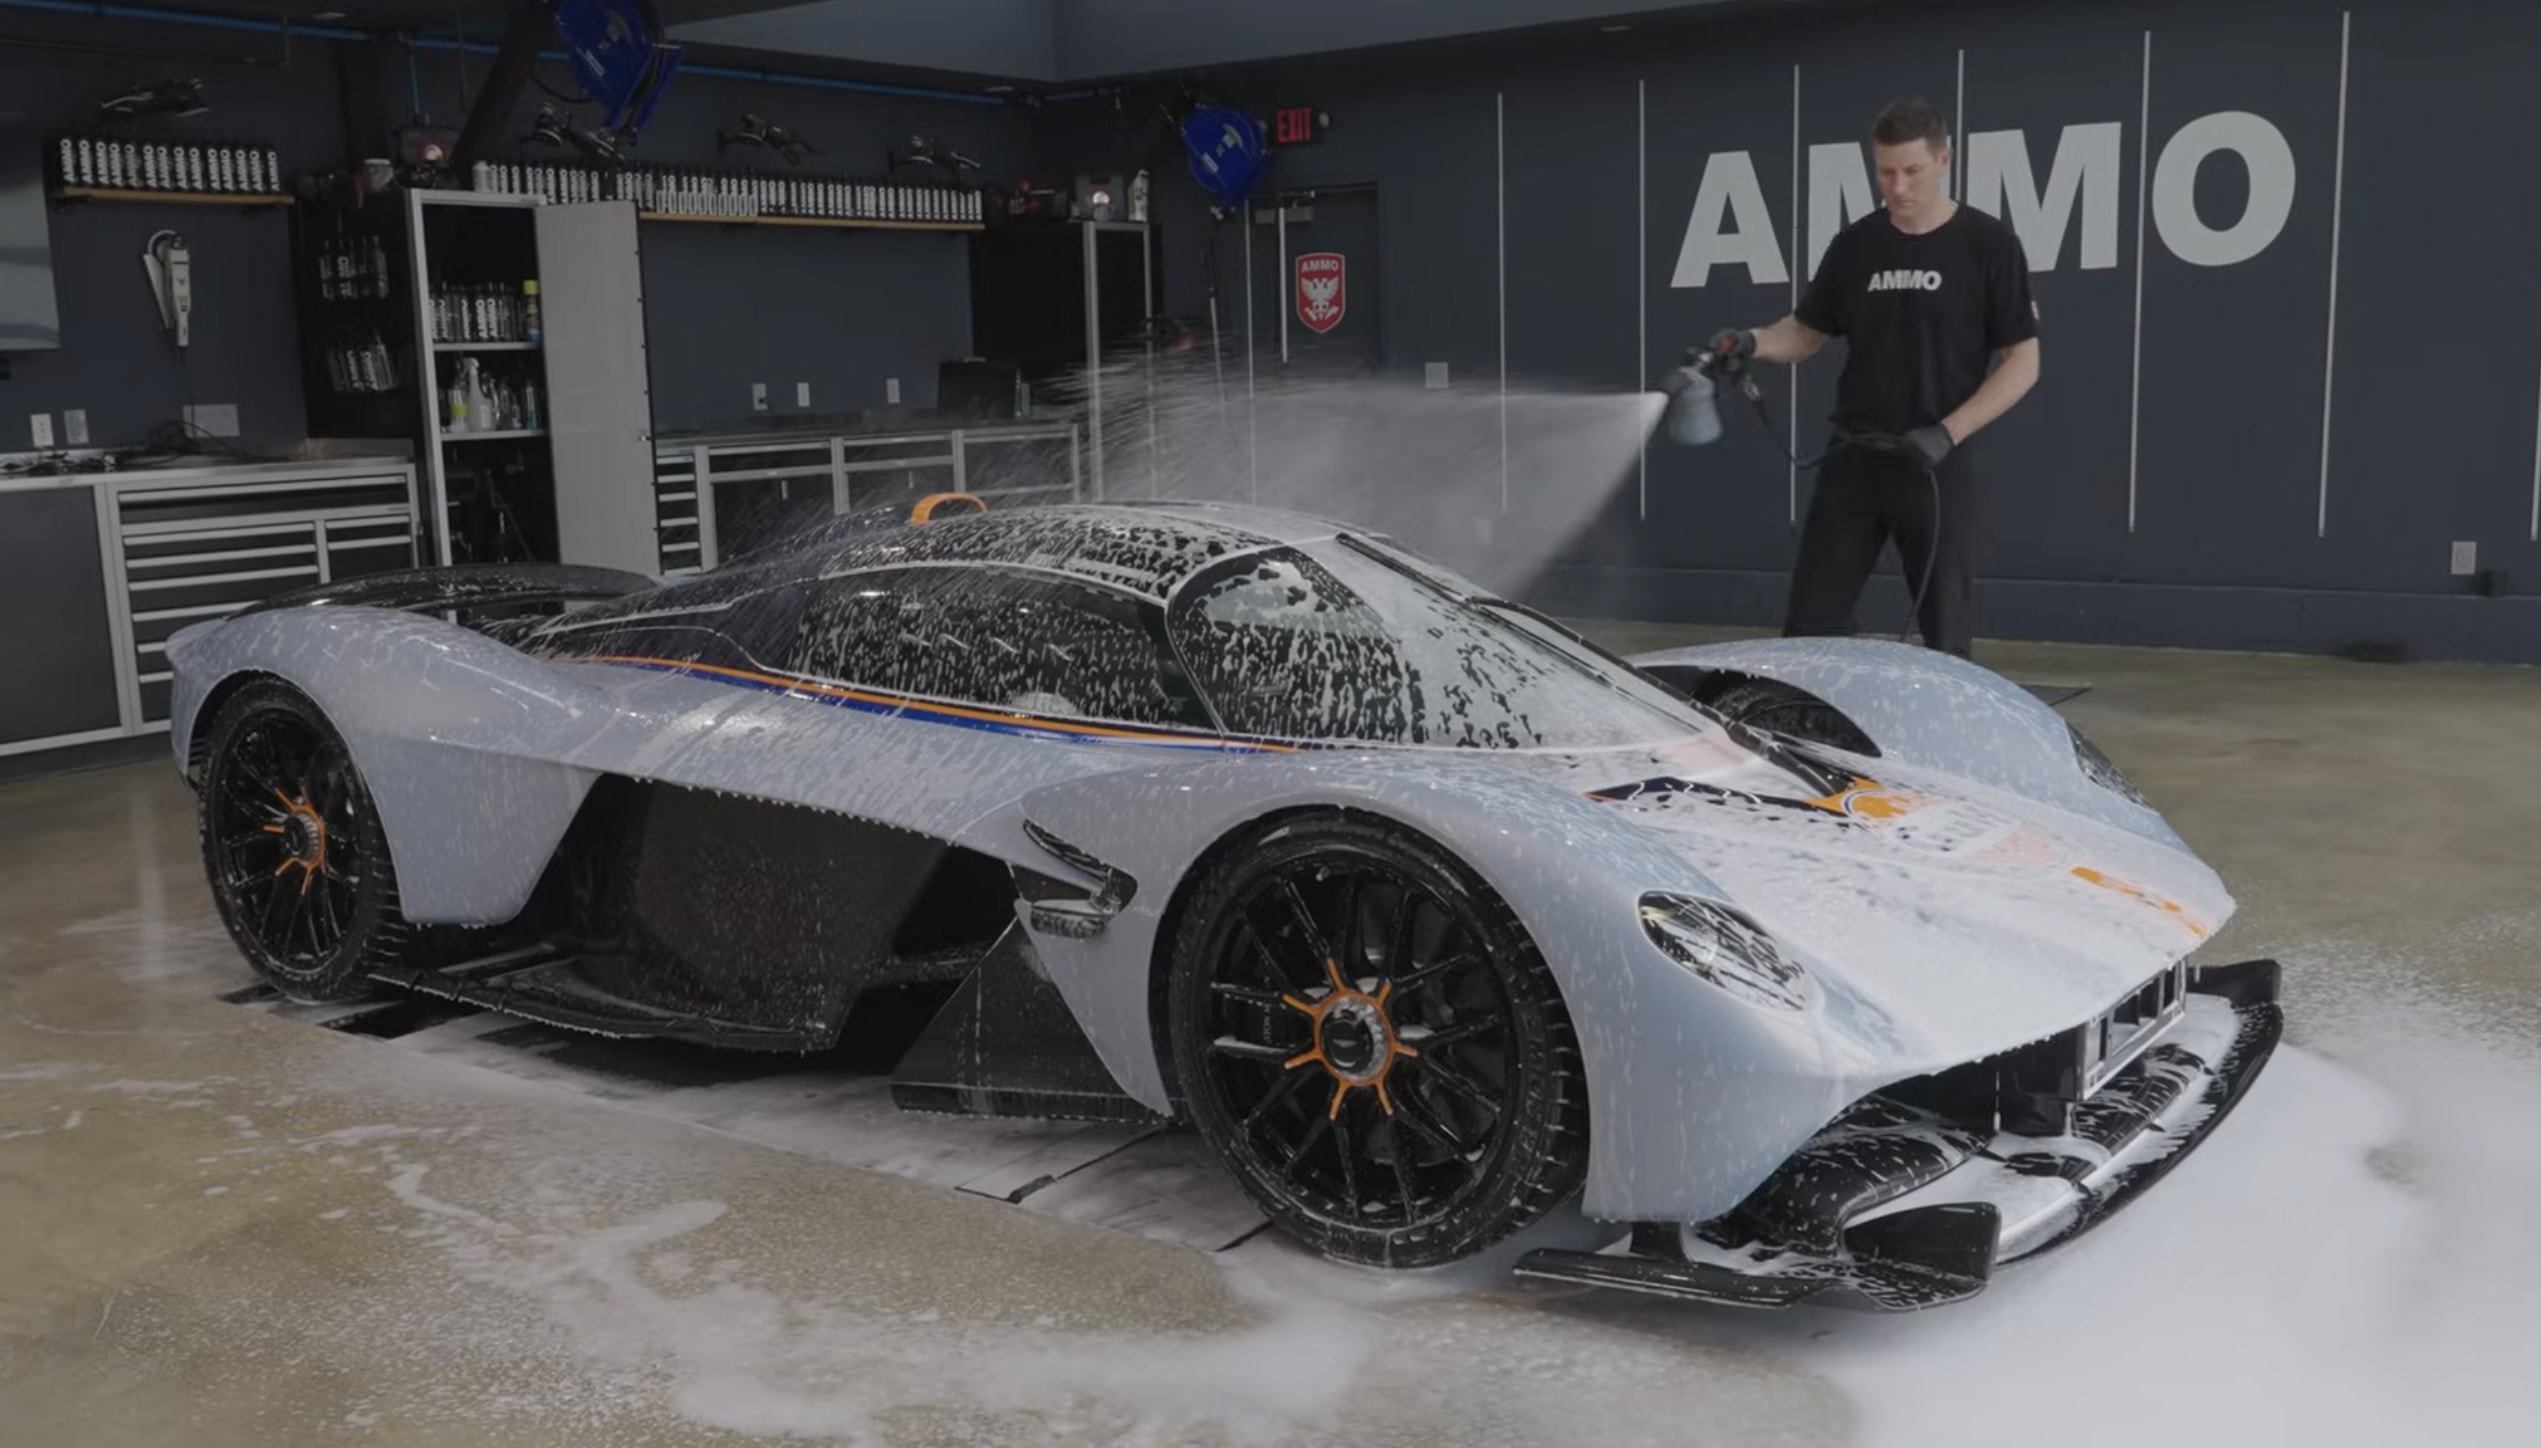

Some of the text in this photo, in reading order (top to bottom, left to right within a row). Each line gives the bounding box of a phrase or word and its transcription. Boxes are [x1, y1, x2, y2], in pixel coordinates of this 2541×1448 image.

[1277, 108, 1311, 143] EXIT
[1301, 260, 1338, 272] AMMO
[1868, 270, 1942, 292] AMMO
